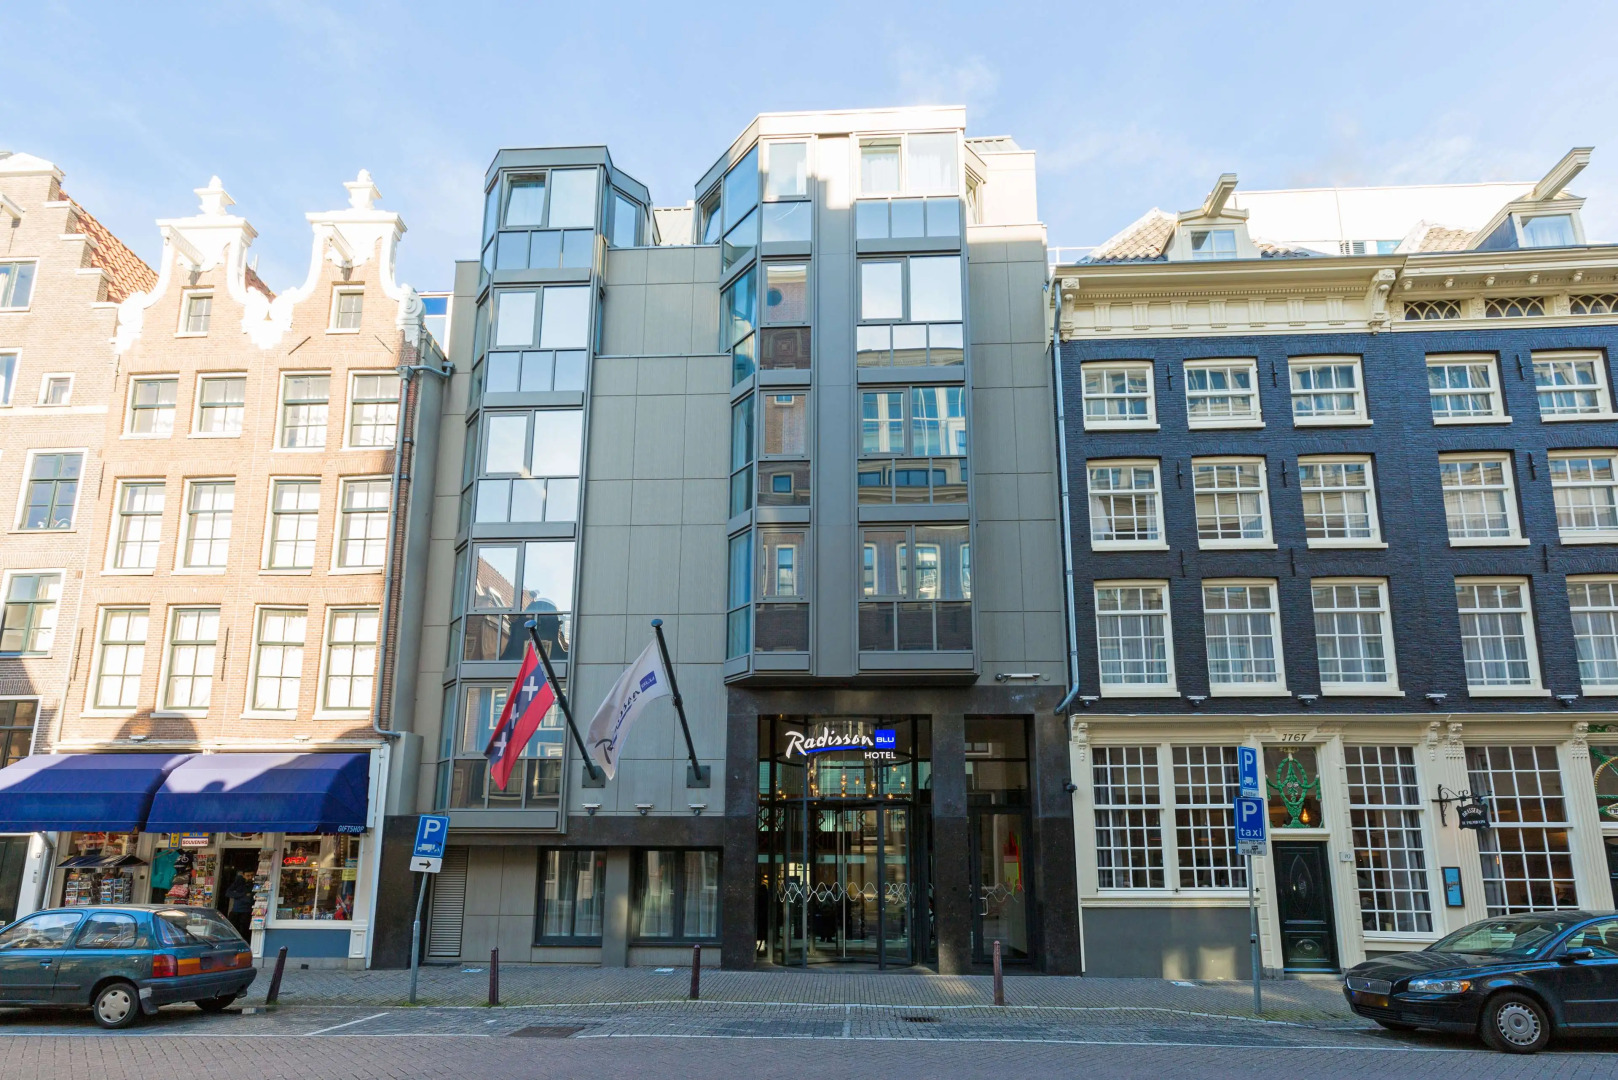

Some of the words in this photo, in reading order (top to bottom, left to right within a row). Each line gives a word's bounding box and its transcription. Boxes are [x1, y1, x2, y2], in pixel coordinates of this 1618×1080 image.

[784, 726, 874, 759] Radisson
[864, 751, 897, 760] HOTEL
[1244, 751, 1254, 772] P
[1241, 801, 1258, 823] P
[337, 824, 365, 833] GIFTSHOP
[423, 819, 441, 840] P
[1240, 827, 1262, 837] taxi
[283, 855, 308, 865] OPEN
